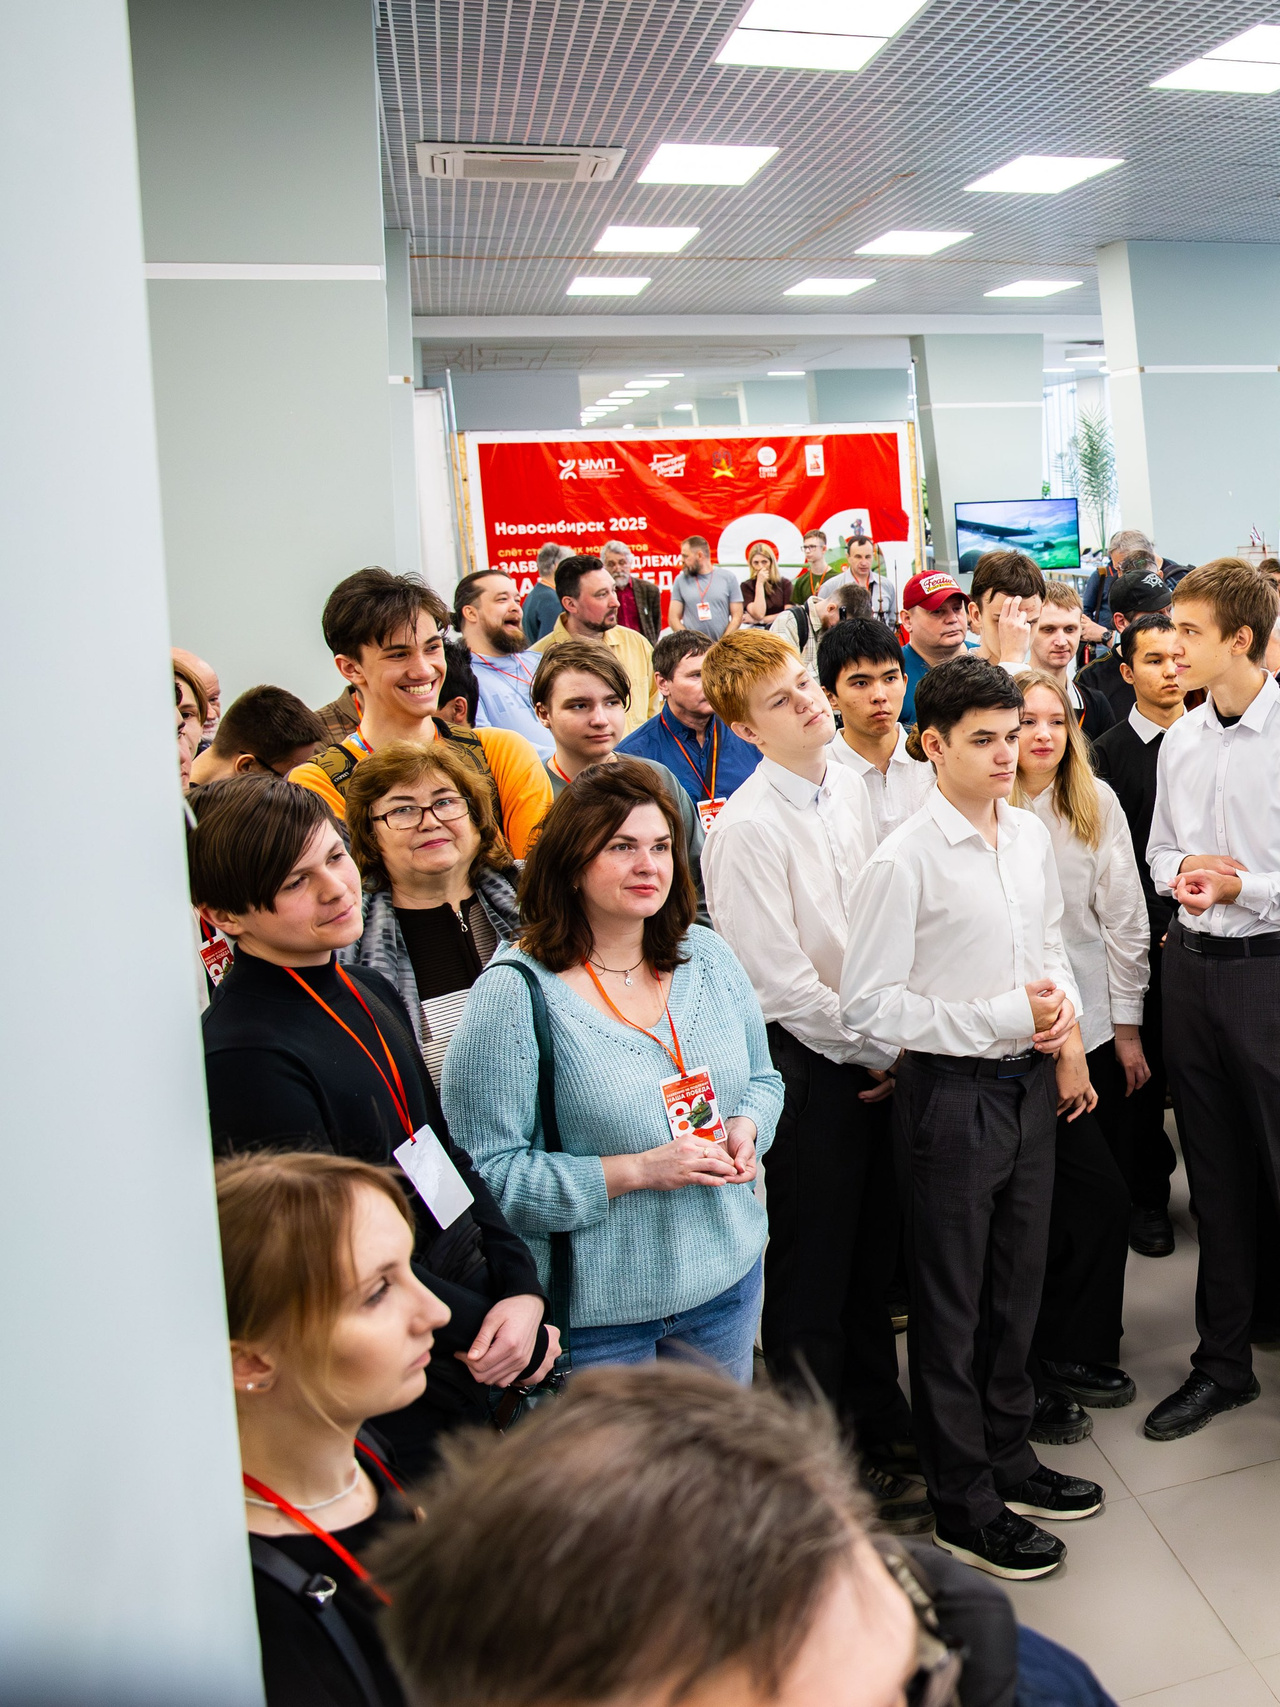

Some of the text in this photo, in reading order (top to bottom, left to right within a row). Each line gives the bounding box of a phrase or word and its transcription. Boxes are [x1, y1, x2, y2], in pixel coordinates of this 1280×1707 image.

[577, 458, 616, 470] УМП
[494, 517, 648, 535] Новосибирск 2025
[667, 1094, 686, 1103] НАША
[686, 1085, 711, 1097] ПОБЕДА
